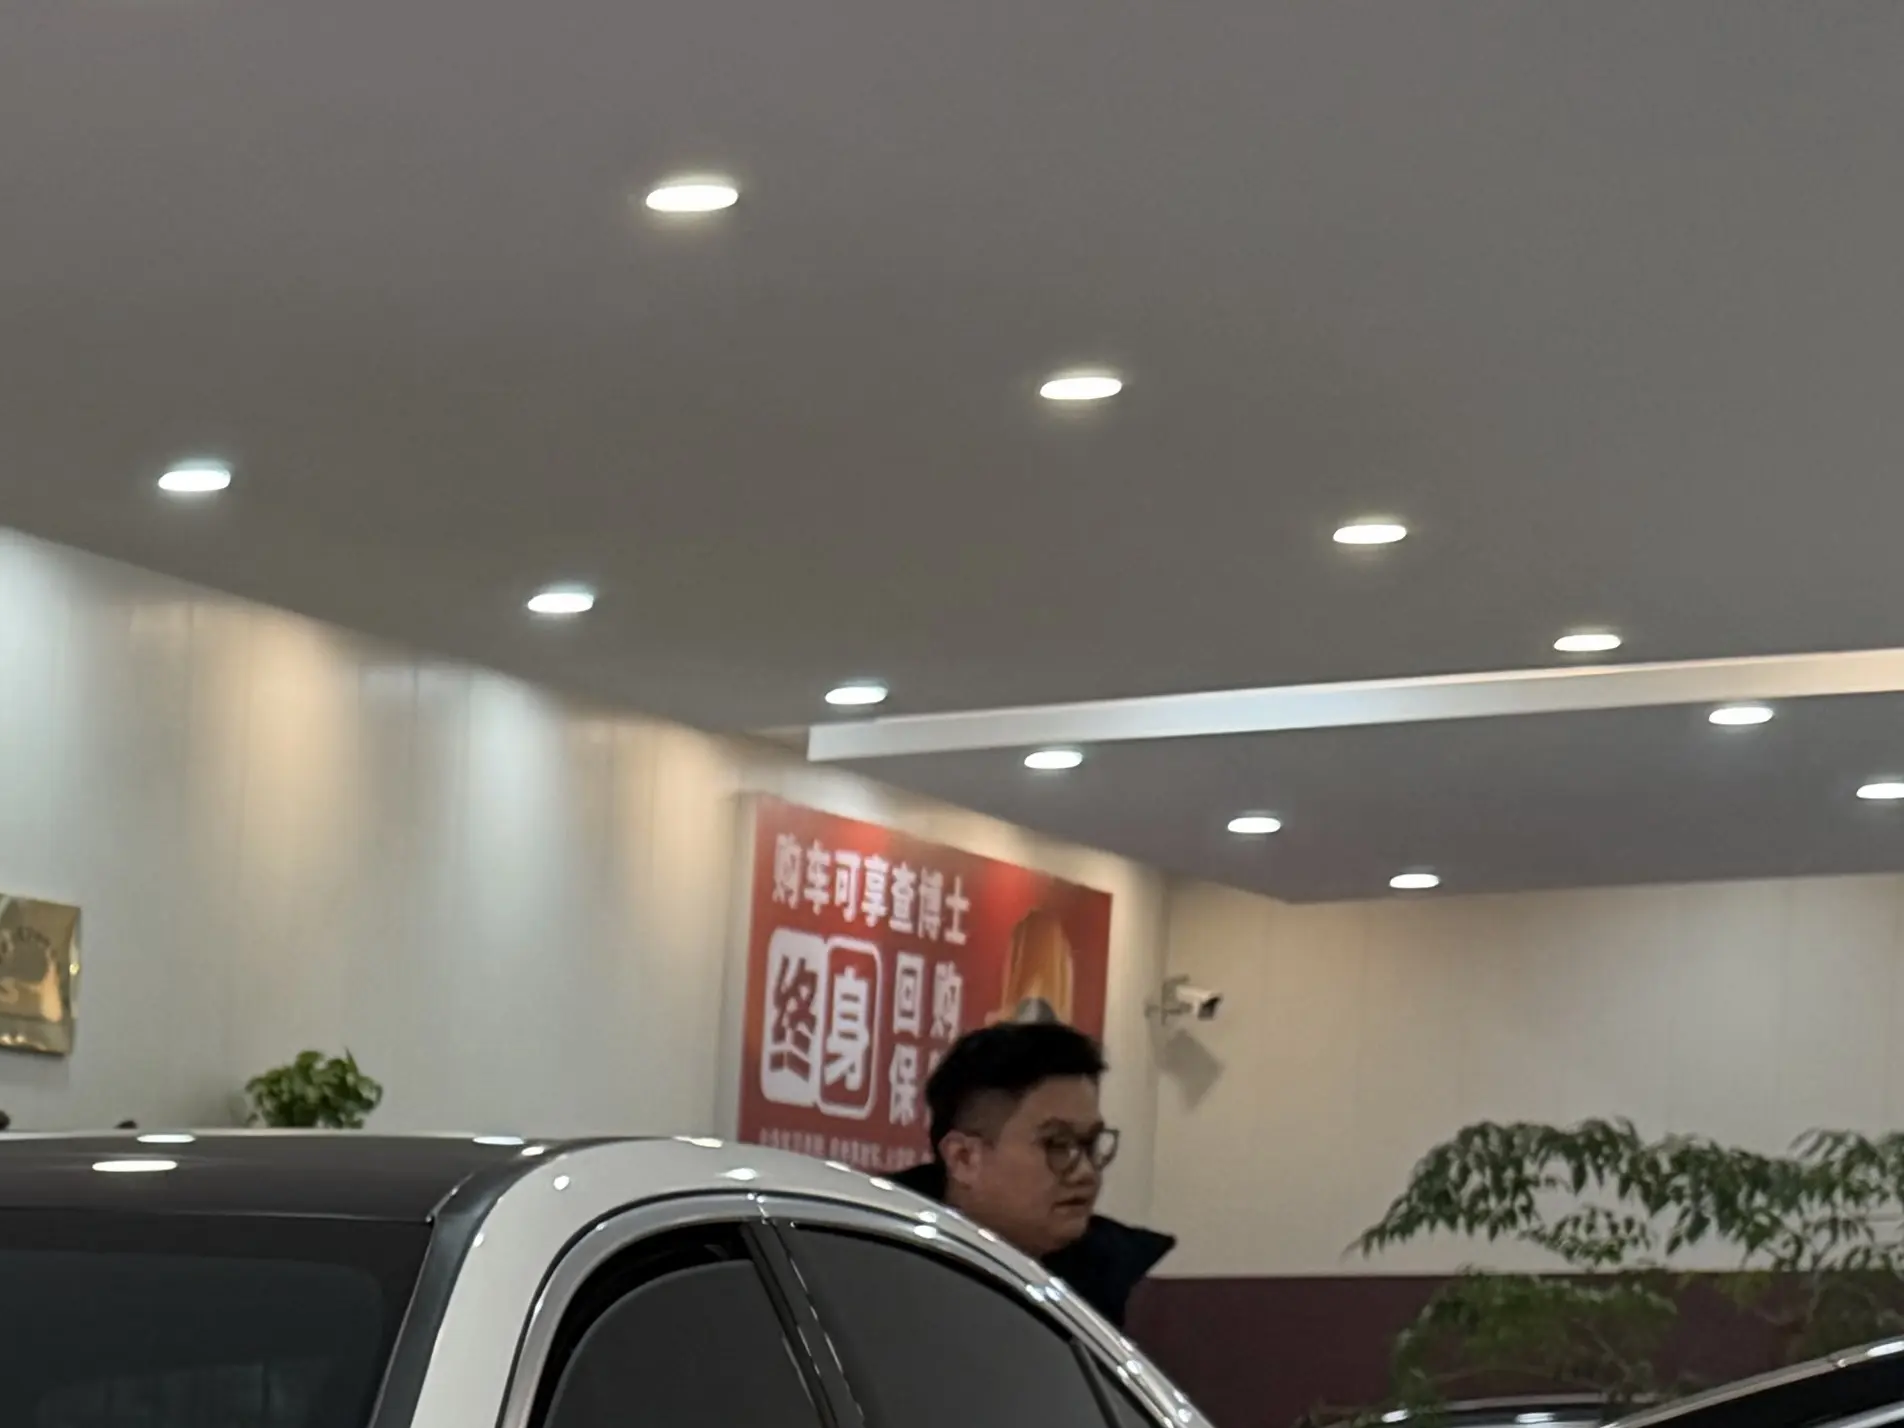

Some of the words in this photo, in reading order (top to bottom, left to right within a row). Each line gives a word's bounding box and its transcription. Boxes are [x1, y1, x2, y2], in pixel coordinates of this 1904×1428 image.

[772, 832, 971, 946] 购车可享查博士
[769, 955, 870, 1092] 终身
[893, 951, 963, 1043] 回购
